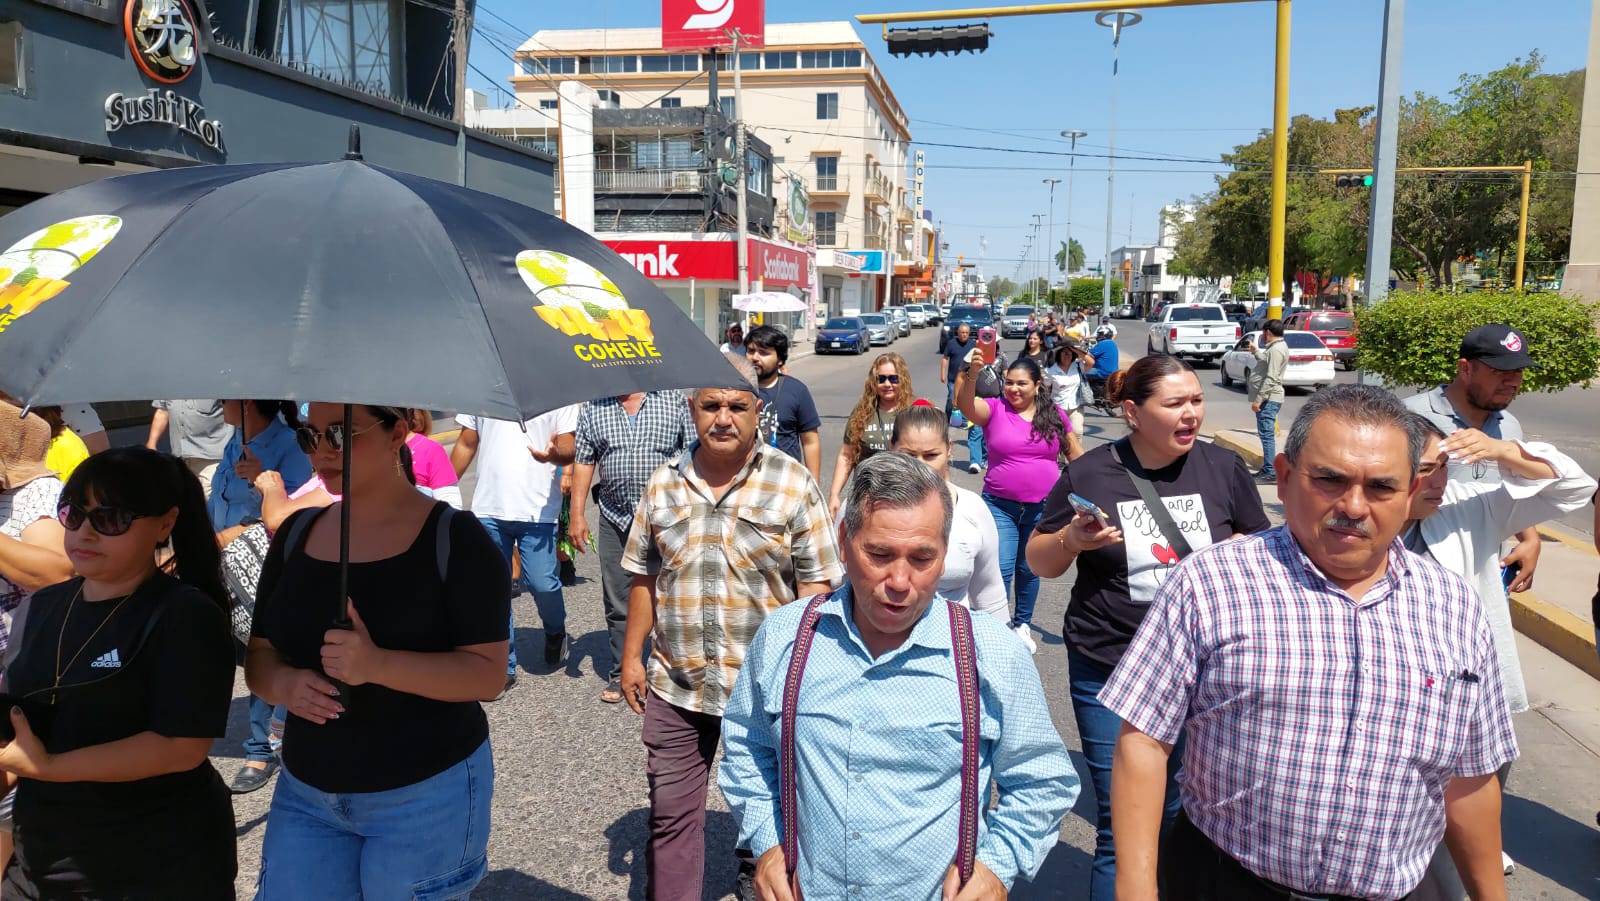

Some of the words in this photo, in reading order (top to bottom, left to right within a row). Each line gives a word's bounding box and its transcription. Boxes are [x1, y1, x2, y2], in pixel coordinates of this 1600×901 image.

[105, 88, 179, 131] Sushi
[178, 95, 224, 153] Koi
[764, 249, 800, 282] Scotiabank
[573, 341, 662, 361] COHEVE
[1120, 503, 1151, 528] yo
[1168, 499, 1194, 512] are
